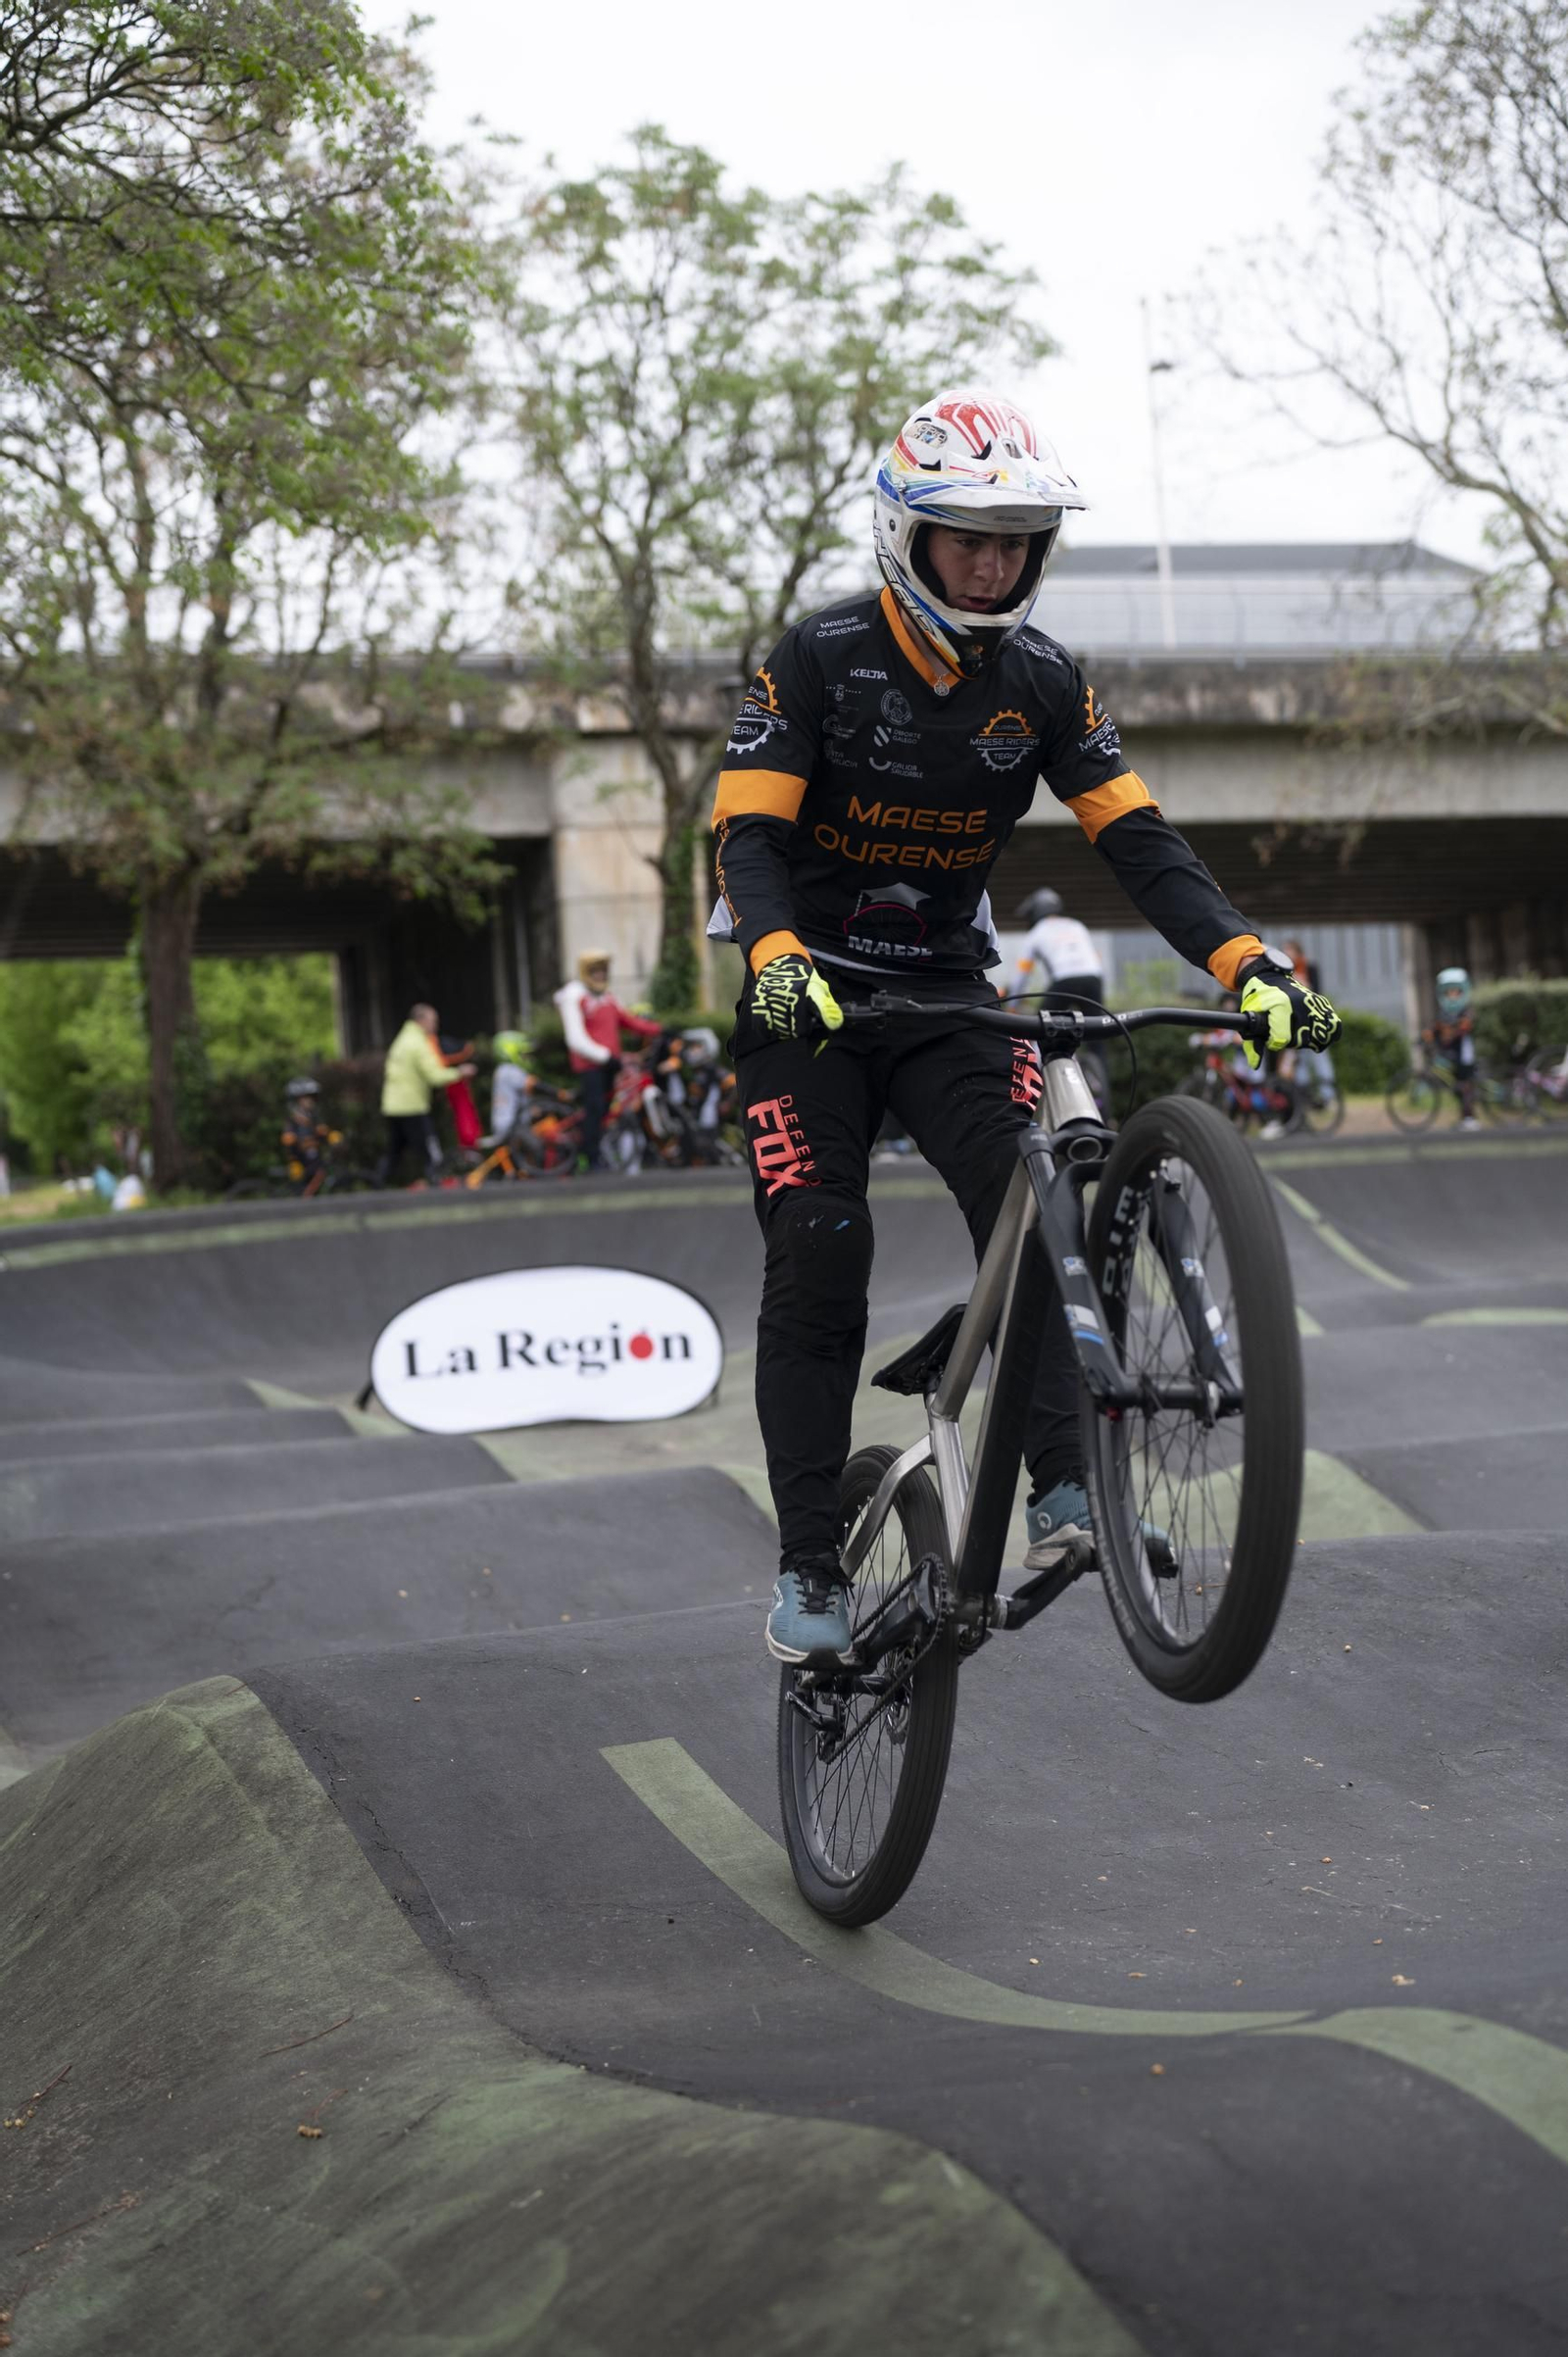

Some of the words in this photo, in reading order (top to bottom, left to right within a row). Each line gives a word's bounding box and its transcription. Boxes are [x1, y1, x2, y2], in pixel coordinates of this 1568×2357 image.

[816, 622, 870, 638] OURENSE
[819, 615, 860, 629] MAESE
[748, 686, 768, 701] ENSE
[969, 737, 1004, 747] MAESE
[1005, 737, 1041, 747] RIDERS
[993, 752, 1017, 761] TEAM
[847, 795, 988, 834] MAESE
[813, 822, 997, 870] OURENSE
[848, 935, 933, 958] MAESE
[747, 1099, 808, 1198] FOX
[778, 1094, 822, 1188] DEFEND
[403, 1338, 478, 1379] La
